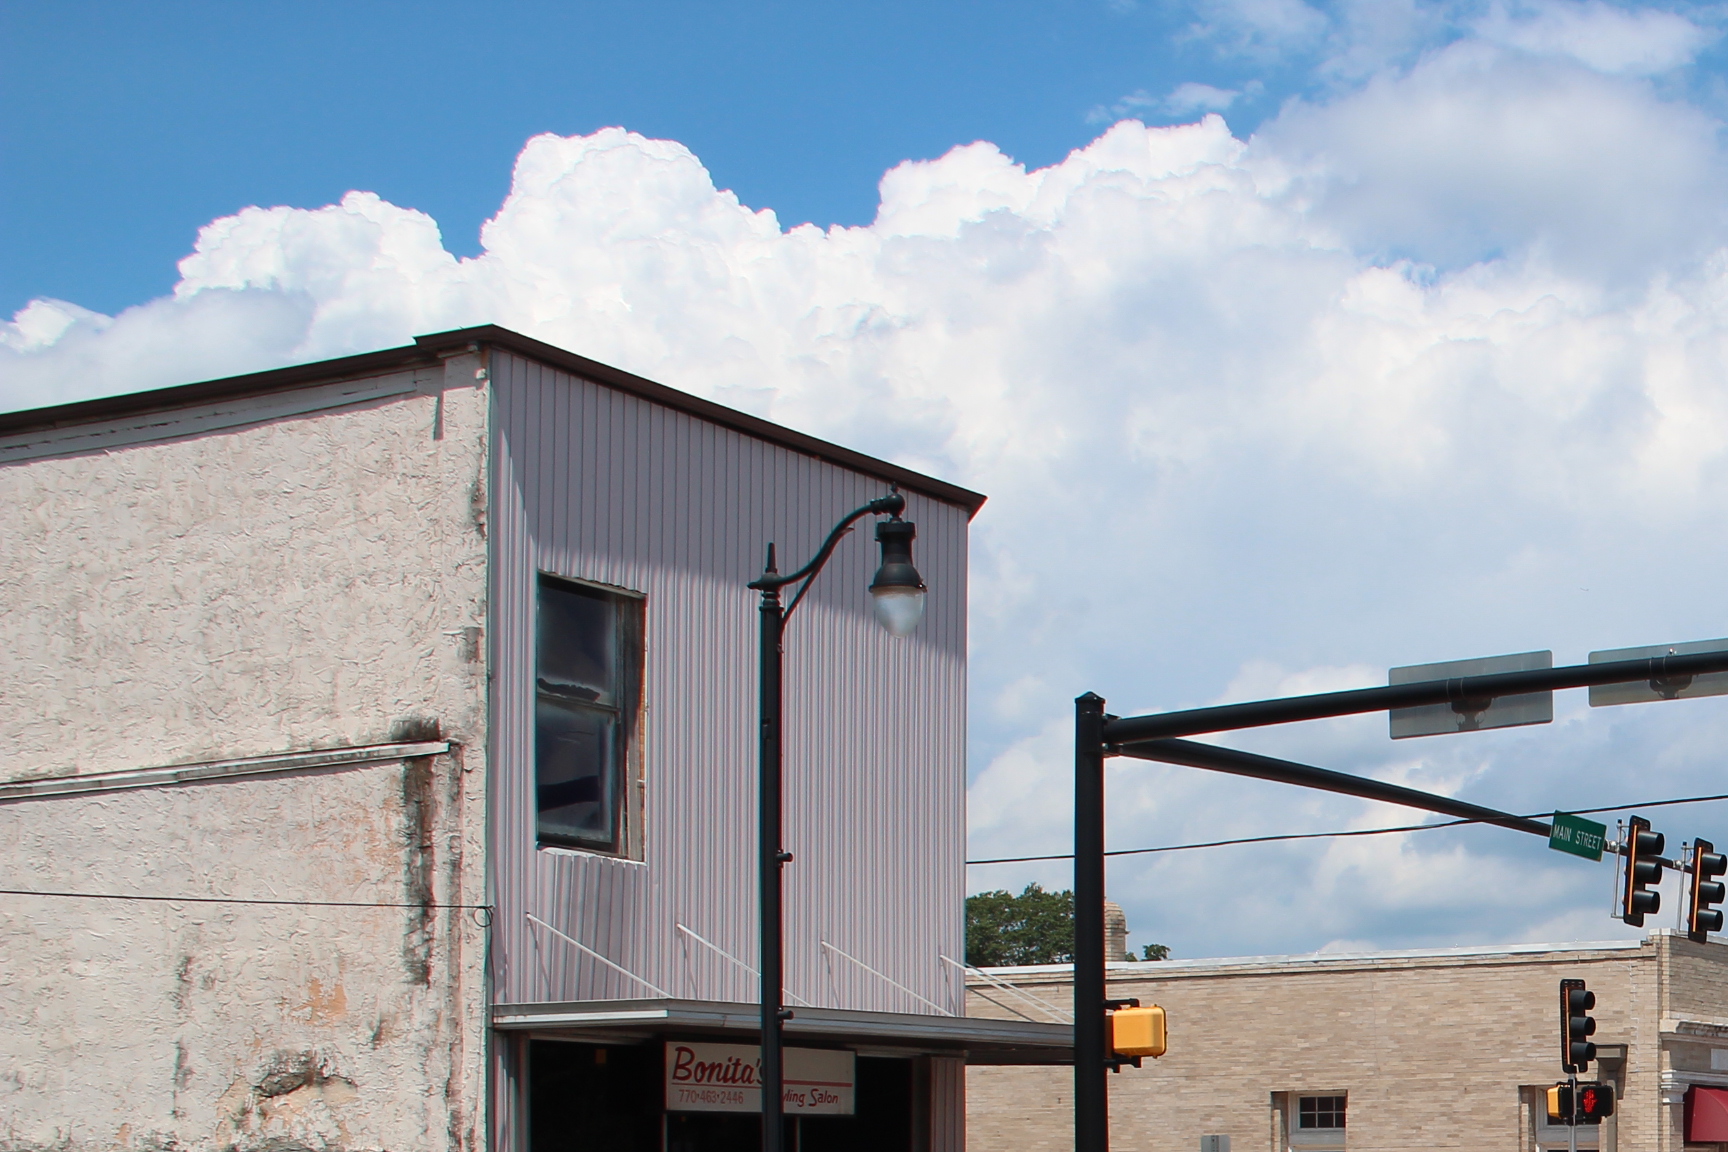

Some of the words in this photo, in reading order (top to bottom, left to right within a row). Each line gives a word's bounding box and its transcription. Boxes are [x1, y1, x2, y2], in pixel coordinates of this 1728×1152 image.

[1553, 824, 1572, 842] MAIN
[1575, 830, 1602, 850] STREET
[783, 1089, 805, 1107] ling
[808, 1088, 839, 1107] Salon
